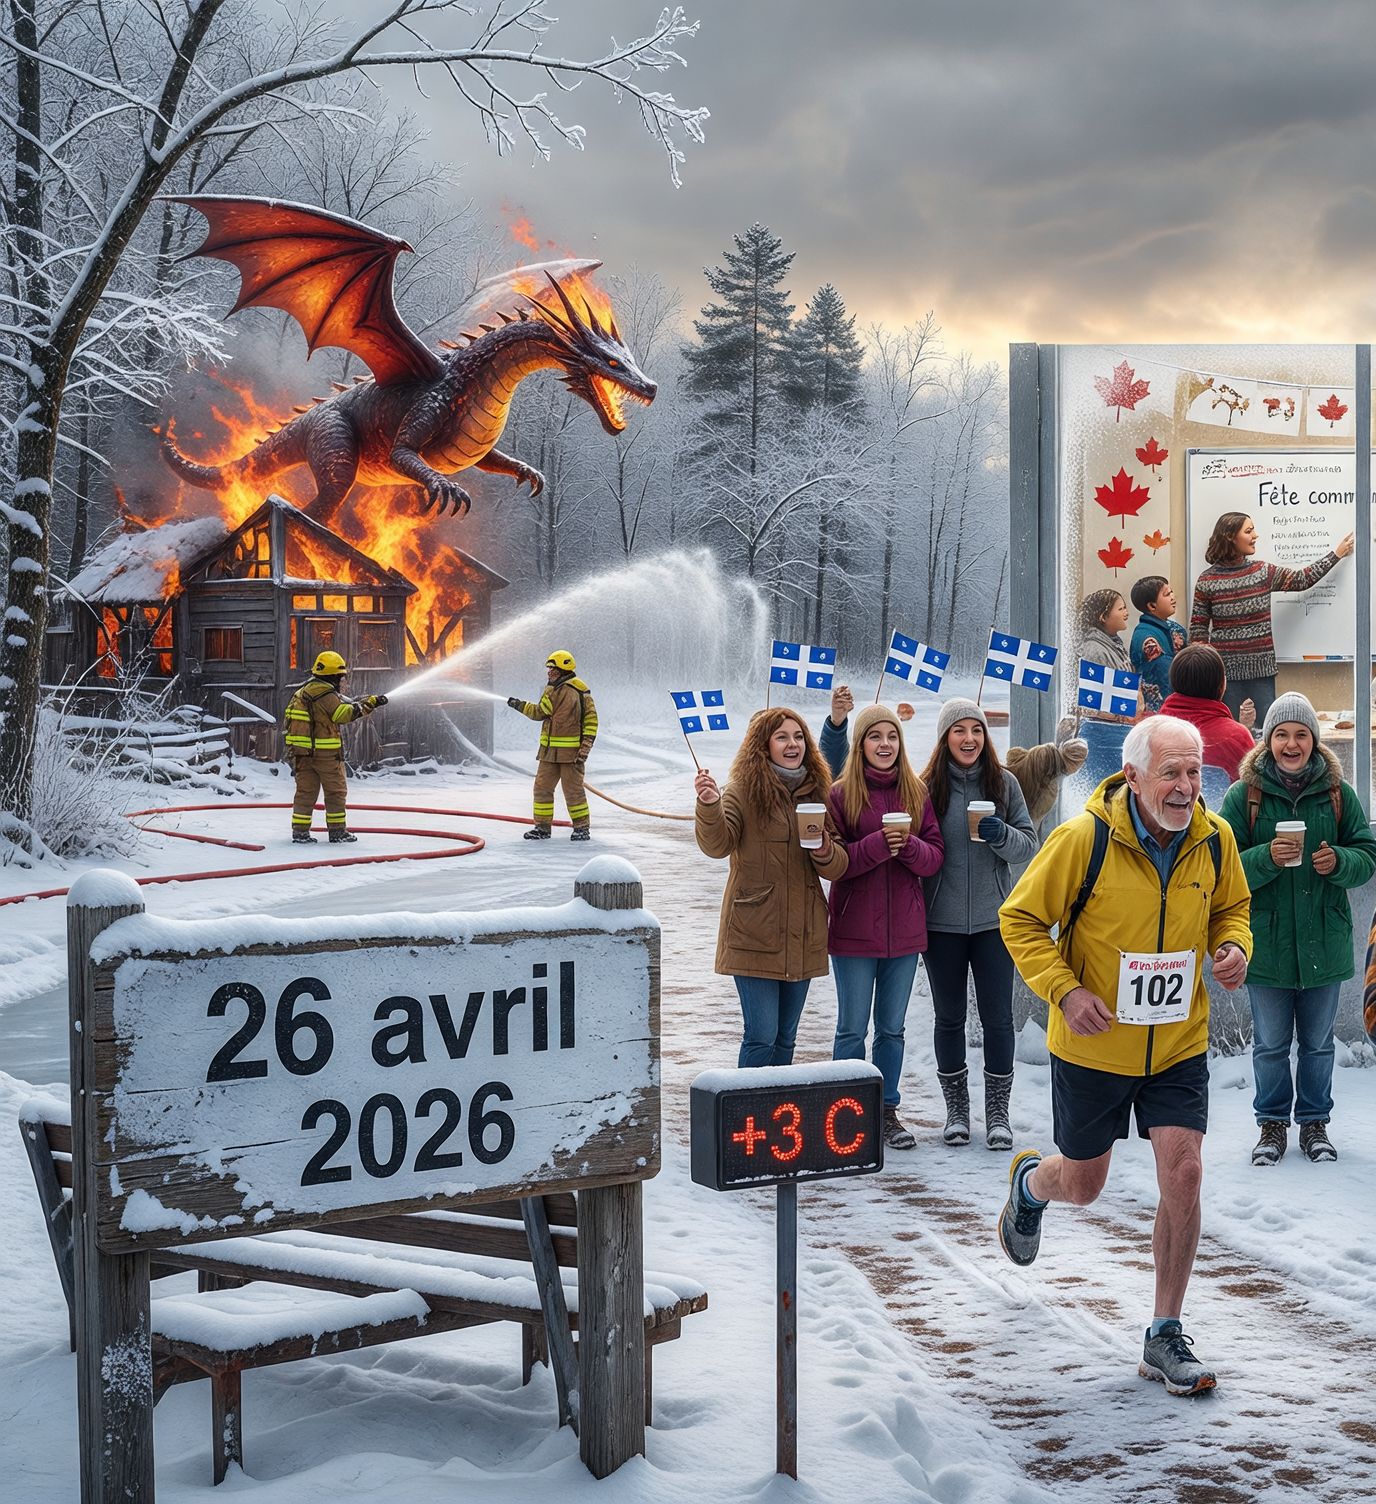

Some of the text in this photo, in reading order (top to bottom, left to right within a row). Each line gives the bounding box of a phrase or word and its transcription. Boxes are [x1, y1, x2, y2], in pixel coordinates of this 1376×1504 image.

[1259, 482, 1300, 506] Fête
[206, 961, 576, 1084] 26 avril
[1130, 974, 1184, 1007] 102
[301, 1082, 516, 1187] 2026
[732, 1097, 865, 1162] +3 C
